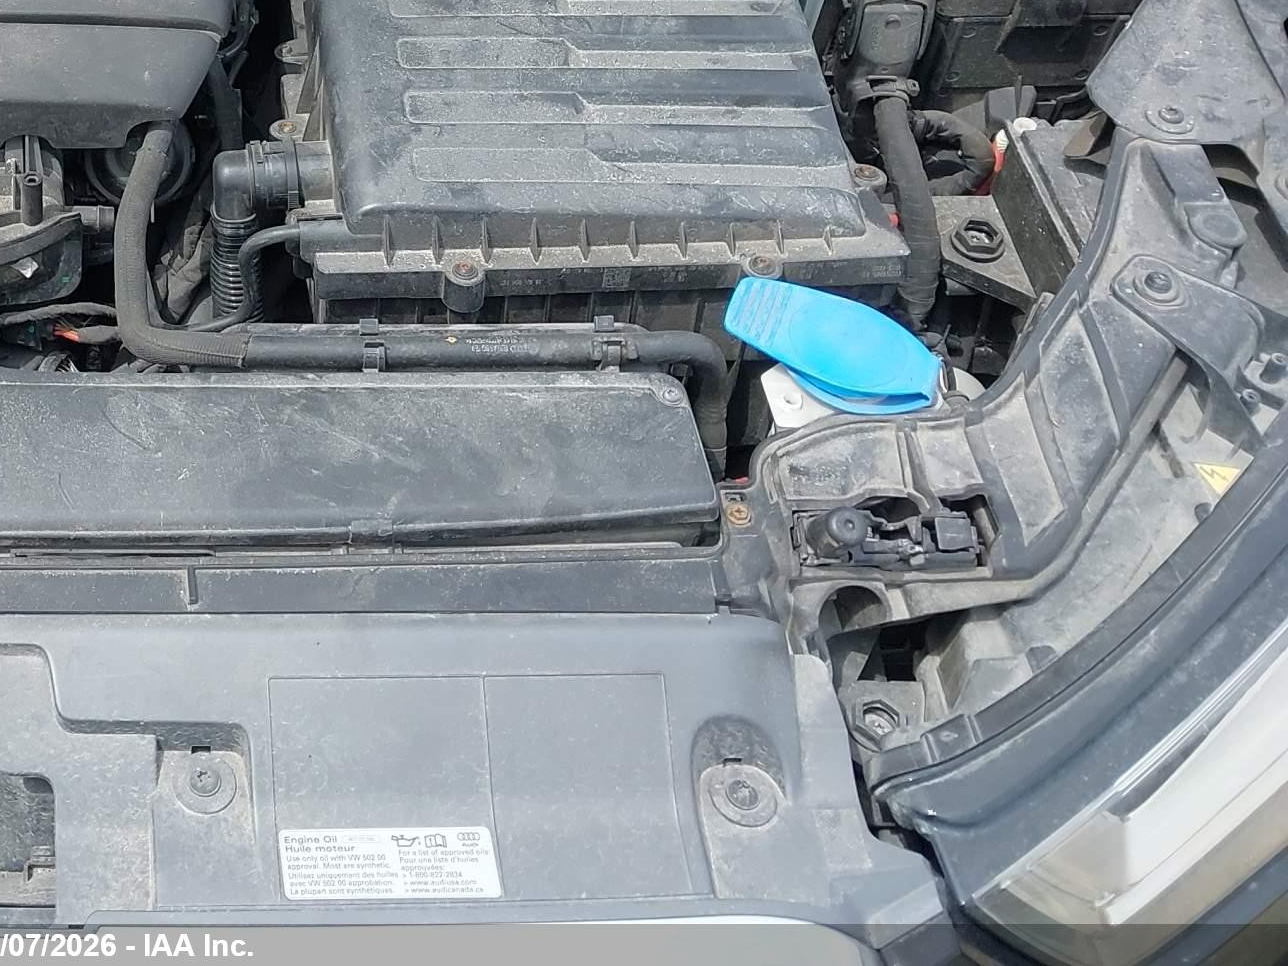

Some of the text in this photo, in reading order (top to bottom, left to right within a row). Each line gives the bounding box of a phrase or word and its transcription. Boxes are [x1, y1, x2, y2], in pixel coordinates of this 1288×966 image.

[284, 836, 320, 845] Engine
[302, 855, 317, 863] only
[317, 872, 360, 880] uniquement
